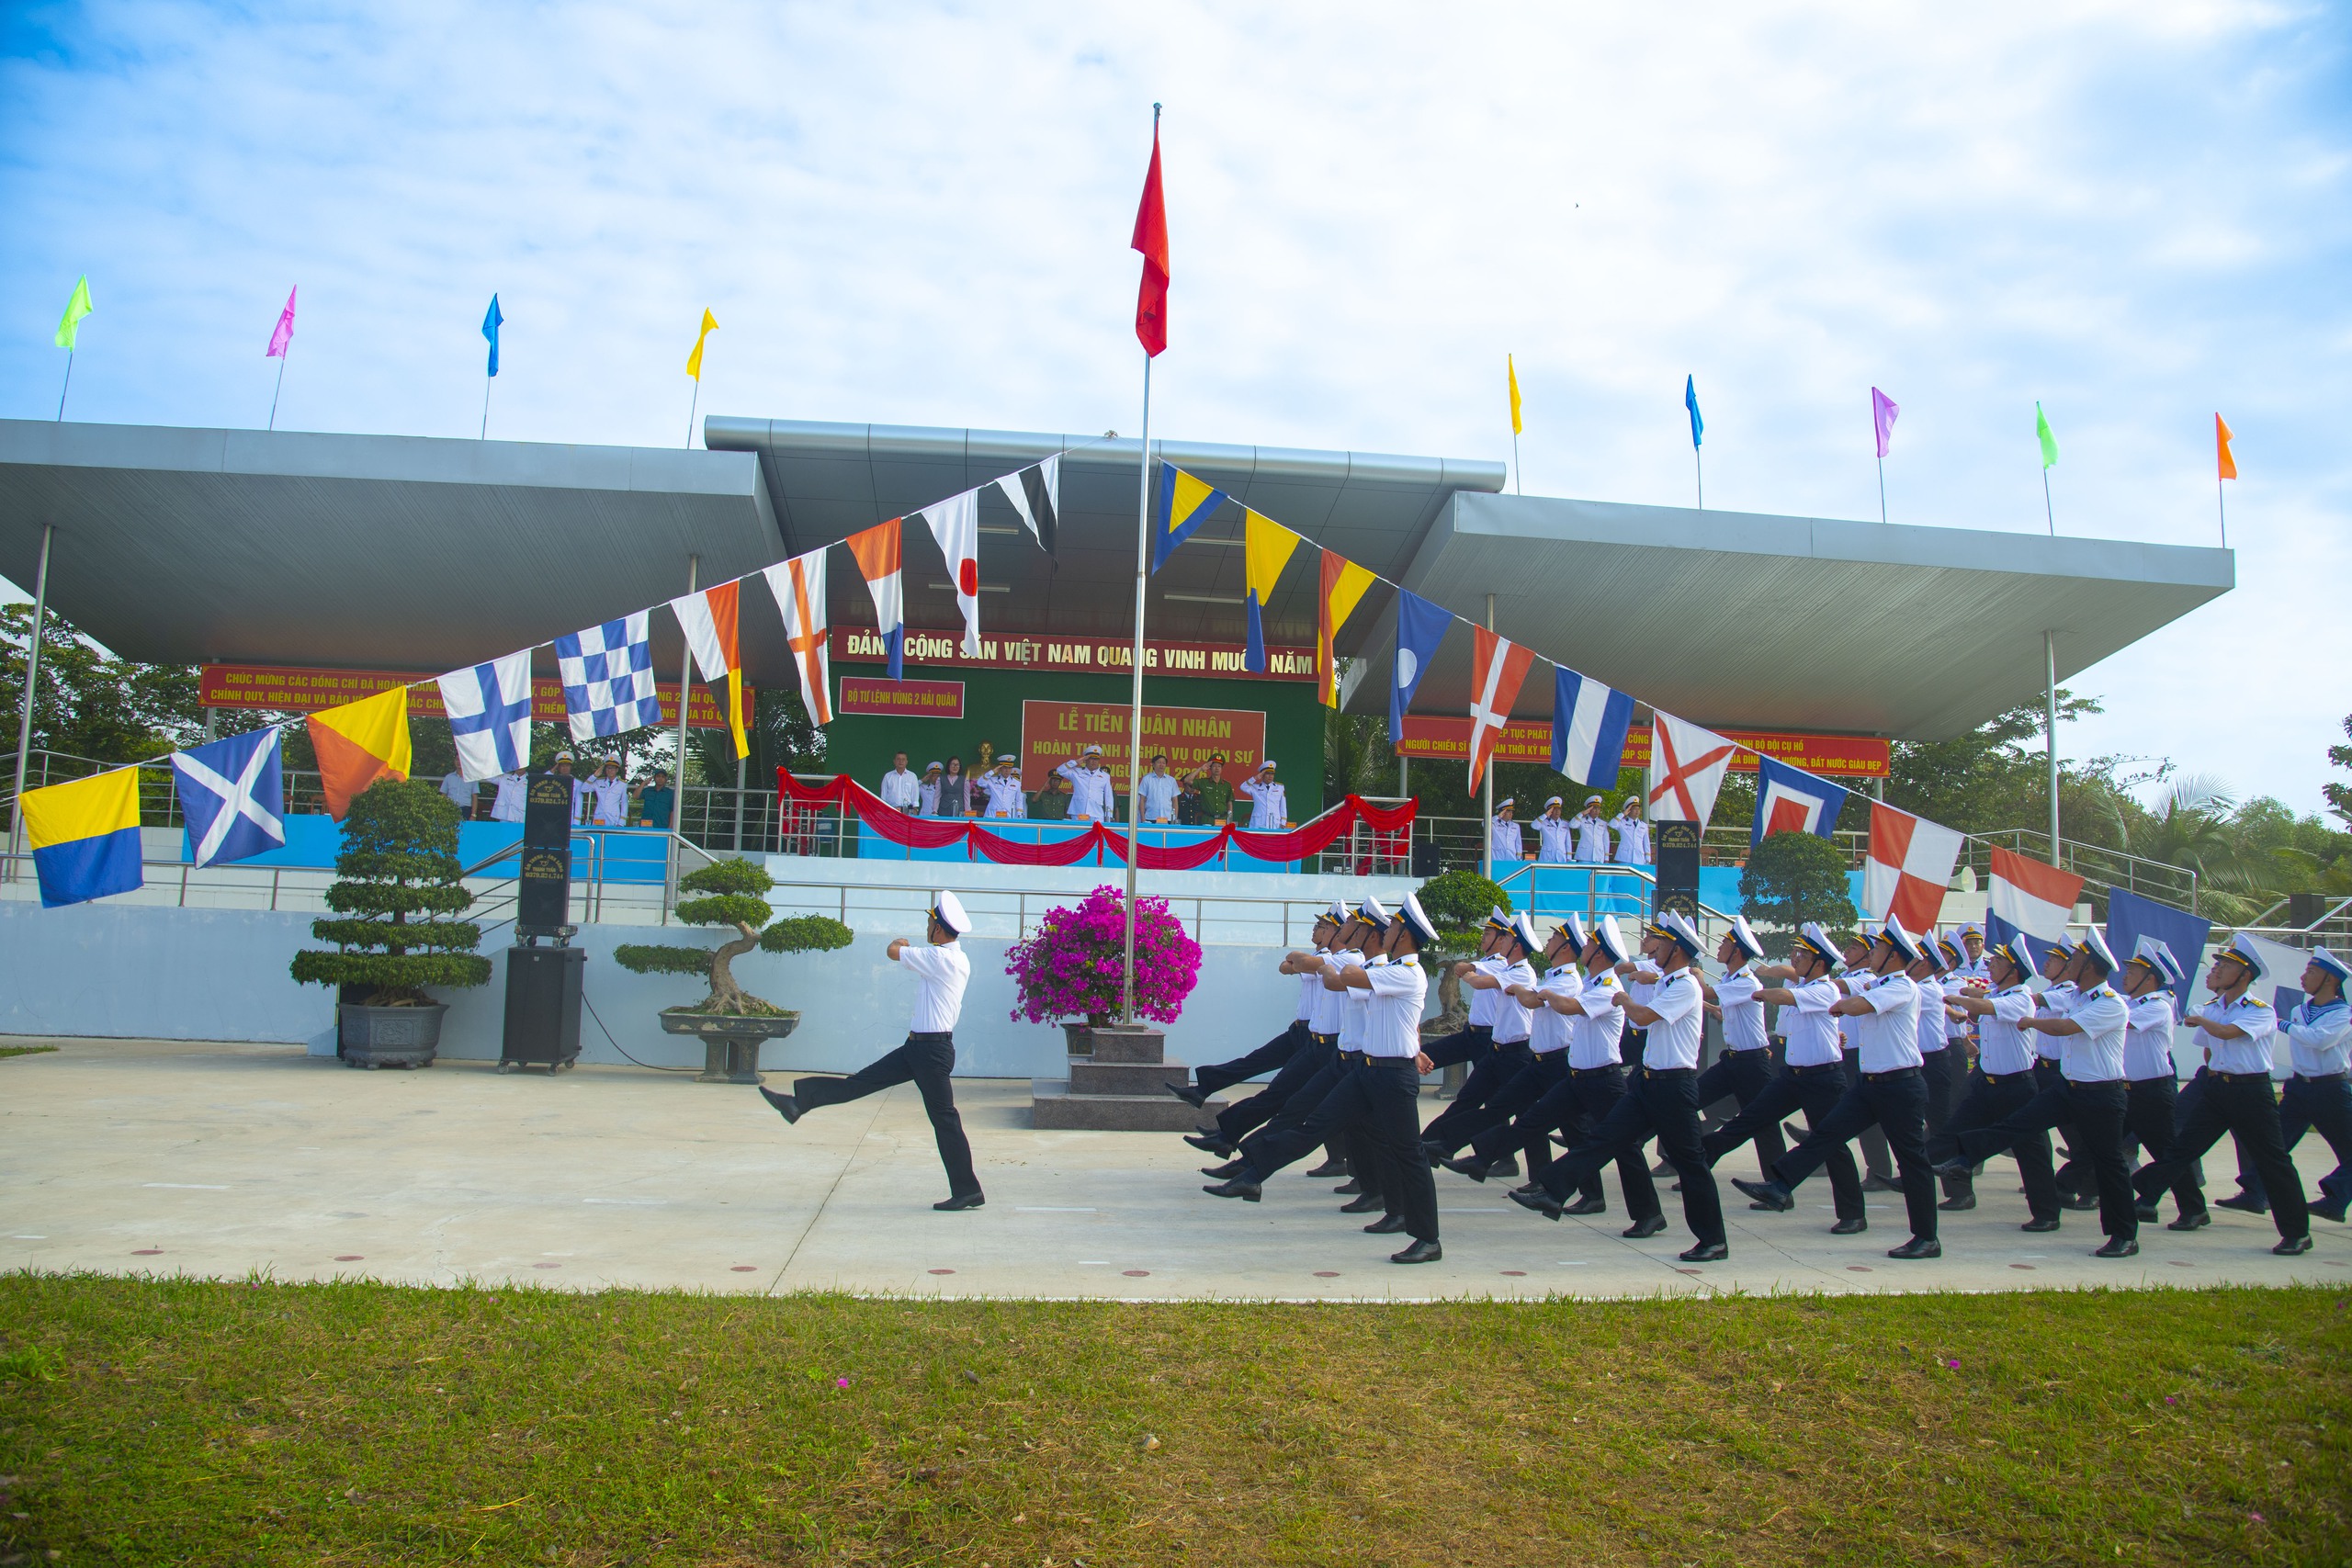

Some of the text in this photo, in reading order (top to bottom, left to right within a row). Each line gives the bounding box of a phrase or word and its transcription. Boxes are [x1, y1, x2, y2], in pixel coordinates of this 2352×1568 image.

[847, 629, 888, 655] ĐẢN
[904, 634, 953, 660] CỘNG
[1004, 638, 1042, 665] VIỆT
[1047, 644, 1091, 664] NAM
[1164, 649, 1205, 670] VINH
[1211, 649, 1250, 671] MUÔ
[1271, 651, 1312, 674] NĂM
[225, 672, 253, 684] CHÚC
[255, 673, 285, 686] MỪNG
[288, 675, 309, 687] CÁC
[341, 677, 358, 689] CHÍ
[360, 677, 374, 690] ĐÃ
[377, 678, 404, 690] HOÀN
[210, 688, 242, 701] CHÍNH
[244, 691, 266, 702] QUY,
[268, 691, 291, 705] HIỆN
[294, 694, 311, 705] ĐẠI
[314, 692, 326, 705] VÀ
[329, 692, 349, 705] BẢO
[541, 685, 561, 697] GÓP
[674, 693, 681, 703] 2
[847, 688, 956, 706] BỘ TƯ LỆNH VÙNG 2 HẢI QUÂN
[702, 706, 713, 720] TỔ
[1058, 706, 1079, 731] LỄ
[1084, 708, 1123, 733] TIỄN
[1182, 716, 1231, 739] NHÂN
[1510, 728, 1525, 740] TỤC
[1527, 728, 1547, 739] PHÁT
[1627, 731, 1649, 744] CỐNG
[1405, 739, 1430, 750] NGƯỜI
[1432, 738, 1456, 751] CHIẾN
[1458, 740, 1466, 752] SĨ
[1508, 743, 1525, 754] THỜI
[1527, 743, 1537, 755] KỲ
[1756, 739, 1765, 751] BỘ
[1768, 739, 1780, 752] ĐỘI
[1782, 741, 1792, 753] CỤ
[1033, 739, 1071, 755] HOÀN
[1075, 740, 1120, 758] TNH
[1125, 743, 1167, 761] NGHĨA
[1171, 747, 1189, 763] VỤ
[1234, 749, 1255, 766] SỰ
[1811, 755, 1825, 768] ĐẤT
[1826, 757, 1847, 769] NƯỚC
[1849, 758, 1866, 770] GIÀU
[1867, 761, 1882, 772] ĐẸP
[1114, 783, 1132, 792] Min
